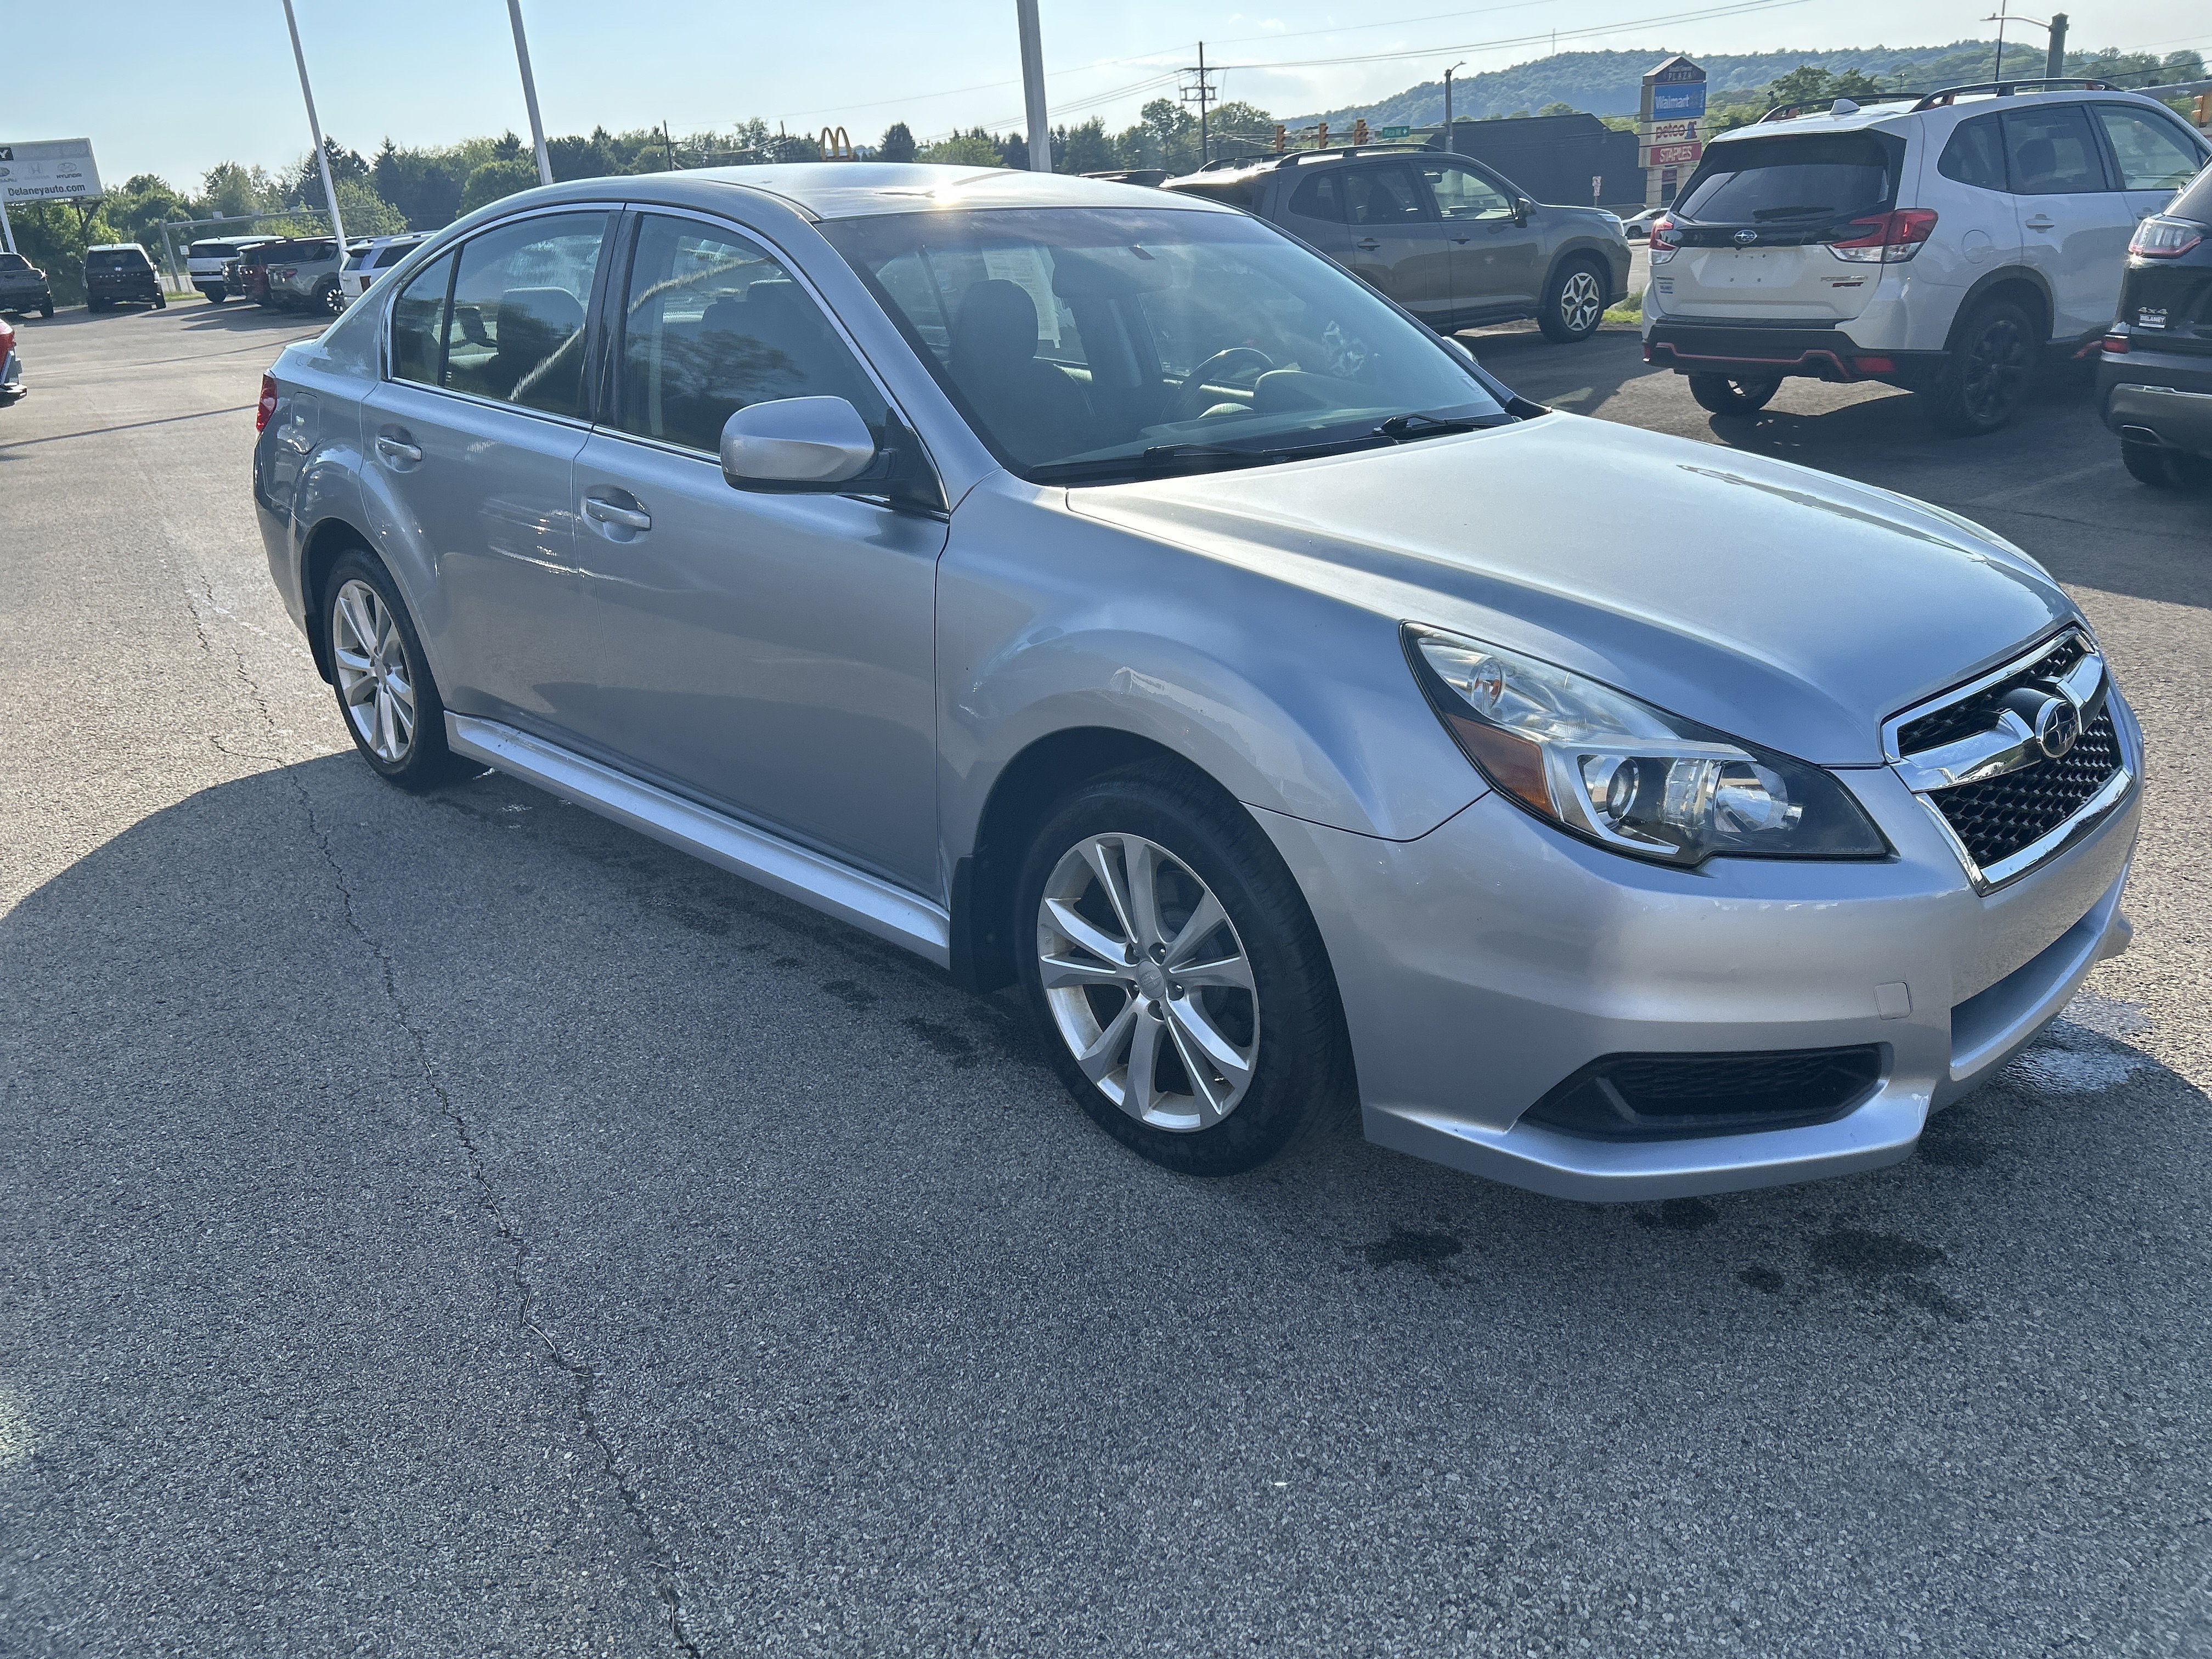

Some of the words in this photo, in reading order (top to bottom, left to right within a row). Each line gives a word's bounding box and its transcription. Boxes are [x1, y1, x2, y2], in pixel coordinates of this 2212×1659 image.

[1668, 72, 1693, 81] PLAZA
[1655, 94, 1689, 110] Walmart
[1656, 123, 1685, 142] petco
[1659, 145, 1692, 162] STAPLES
[8, 184, 86, 196] Delaneyauto.com
[2138, 307, 2169, 315] 4x4
